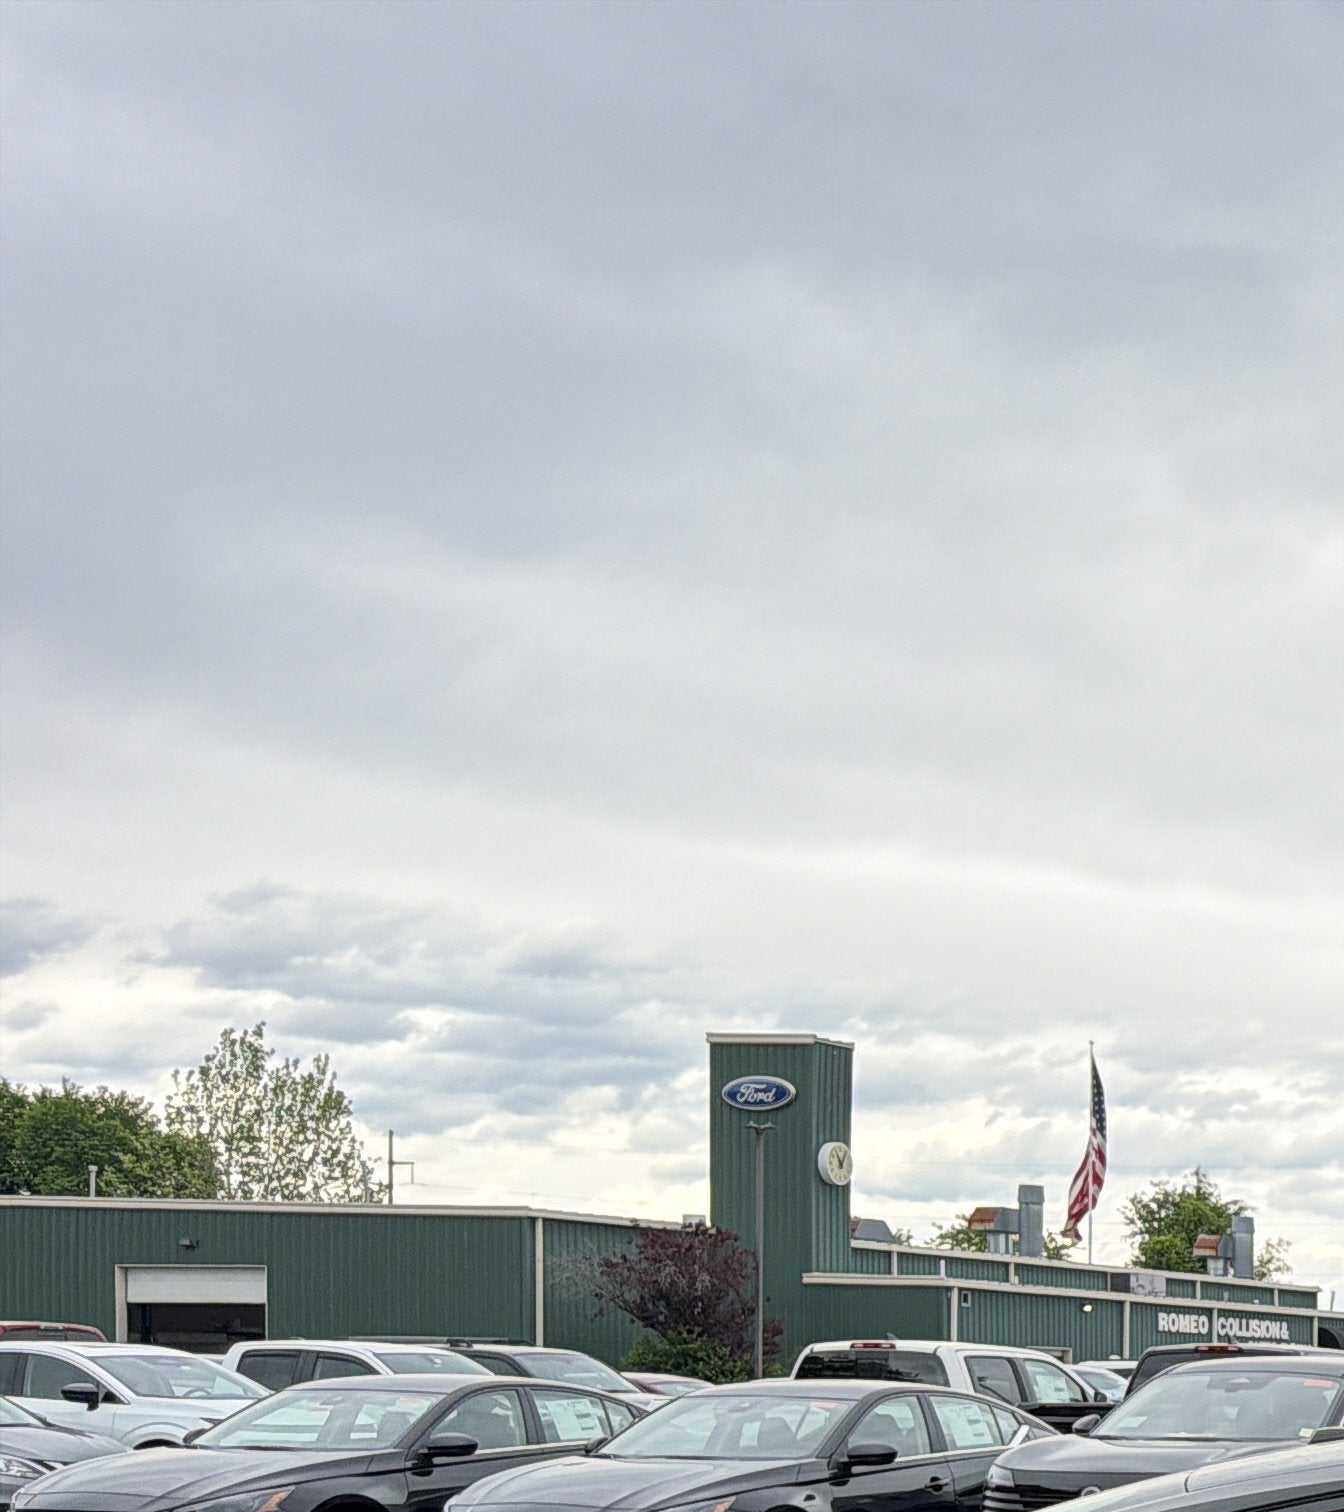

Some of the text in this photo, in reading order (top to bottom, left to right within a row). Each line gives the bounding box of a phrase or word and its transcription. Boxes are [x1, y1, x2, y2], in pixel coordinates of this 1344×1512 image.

[737, 1083, 777, 1103] Ford
[1158, 1312, 1290, 1340] ROMEO COLLISION &
